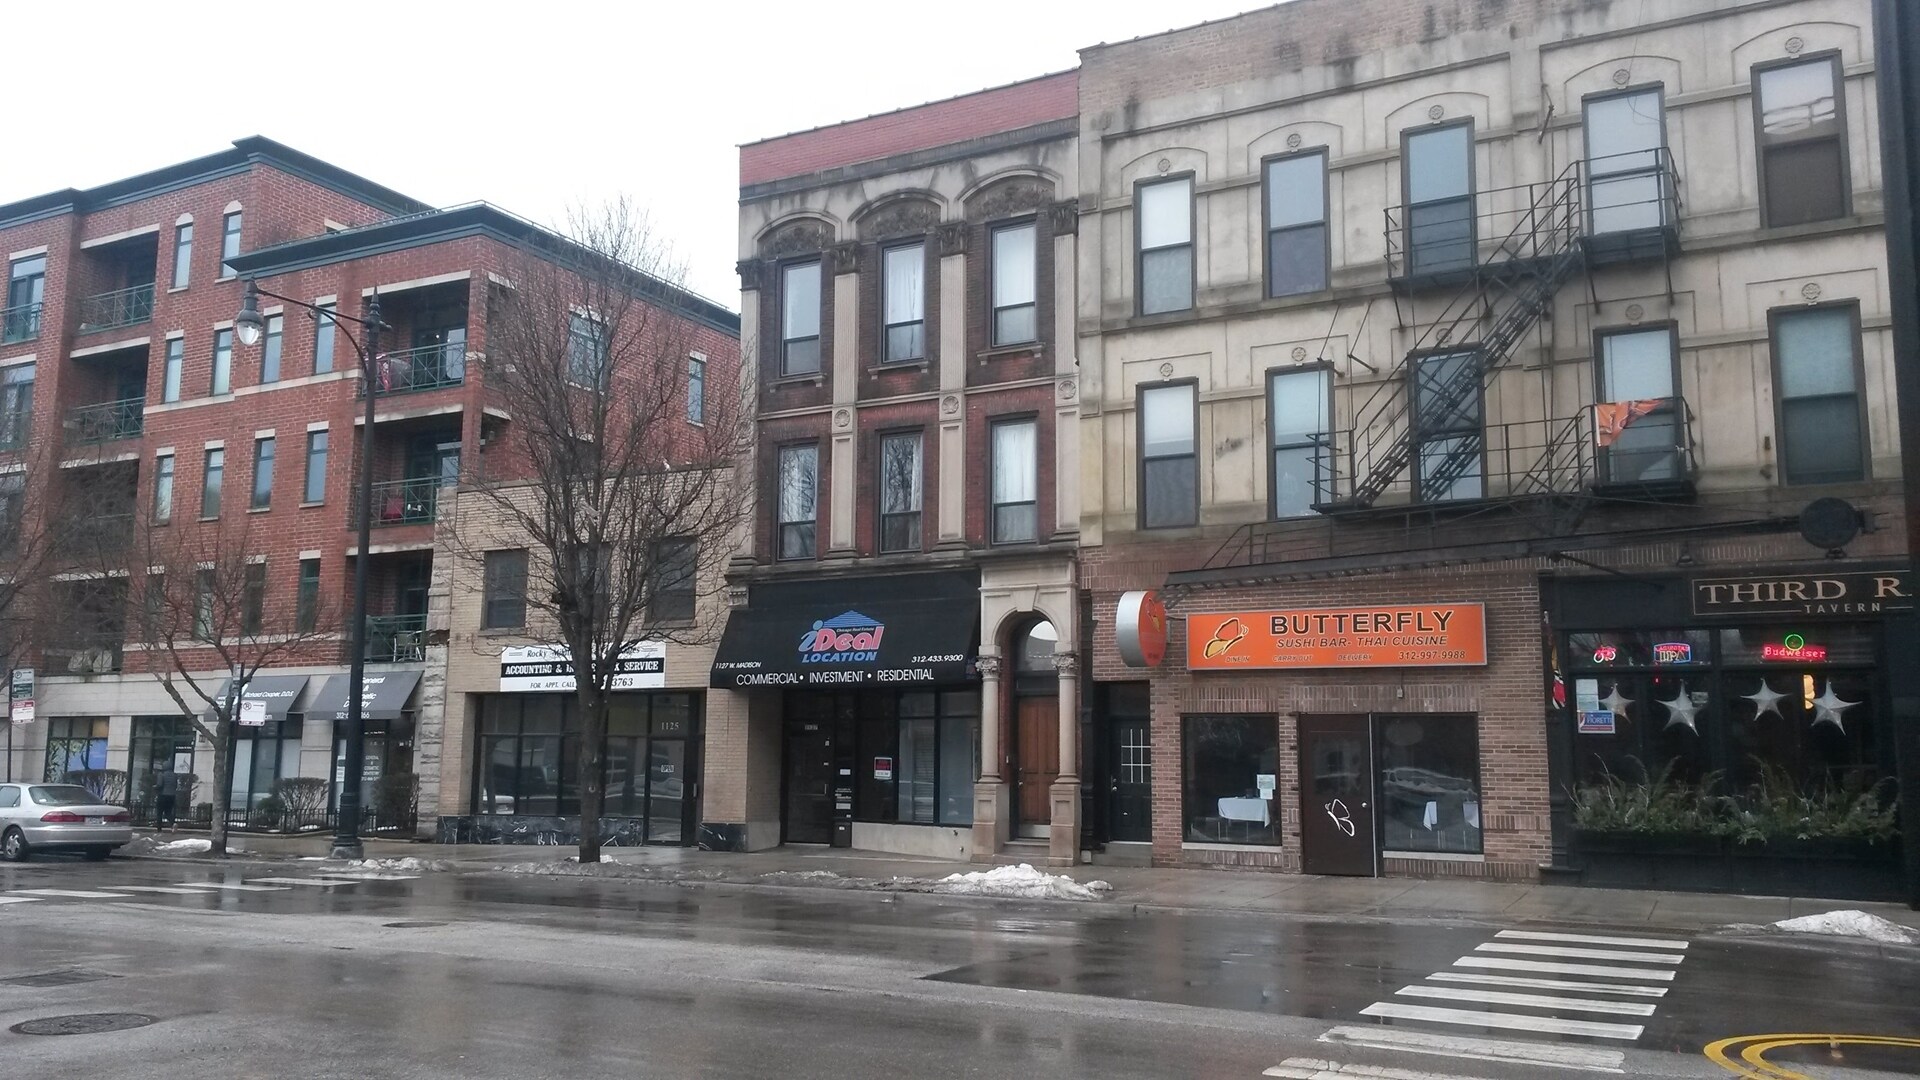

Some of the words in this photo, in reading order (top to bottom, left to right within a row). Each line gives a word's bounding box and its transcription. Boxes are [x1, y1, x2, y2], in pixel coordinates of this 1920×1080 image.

[1699, 579, 1847, 604] THIRD
[1873, 577, 1913, 598] R
[1804, 602, 1881, 614] TAVERN
[1269, 610, 1454, 636] BUTTERFLY
[1276, 637, 1316, 648] SUSHI
[1357, 636, 1388, 647] THAI
[1392, 635, 1448, 646] CUISINE
[801, 651, 878, 663] LOCATION
[1272, 655, 1296, 663] CARRY
[1298, 654, 1314, 662] OUT
[1398, 651, 1466, 660] 312-997-9988
[1764, 646, 1826, 658] Budweiser
[911, 654, 964, 663] 312.433.9300
[505, 664, 553, 675] ACCOUNTING
[555, 664, 563, 674] &
[624, 661, 659, 671] SERVICE
[736, 661, 762, 669] MADISON
[736, 673, 799, 686] COMMERCIAL
[809, 670, 864, 684] INVESTMENT
[877, 668, 934, 682] RESIDENTIAL
[661, 722, 679, 731] 1125
